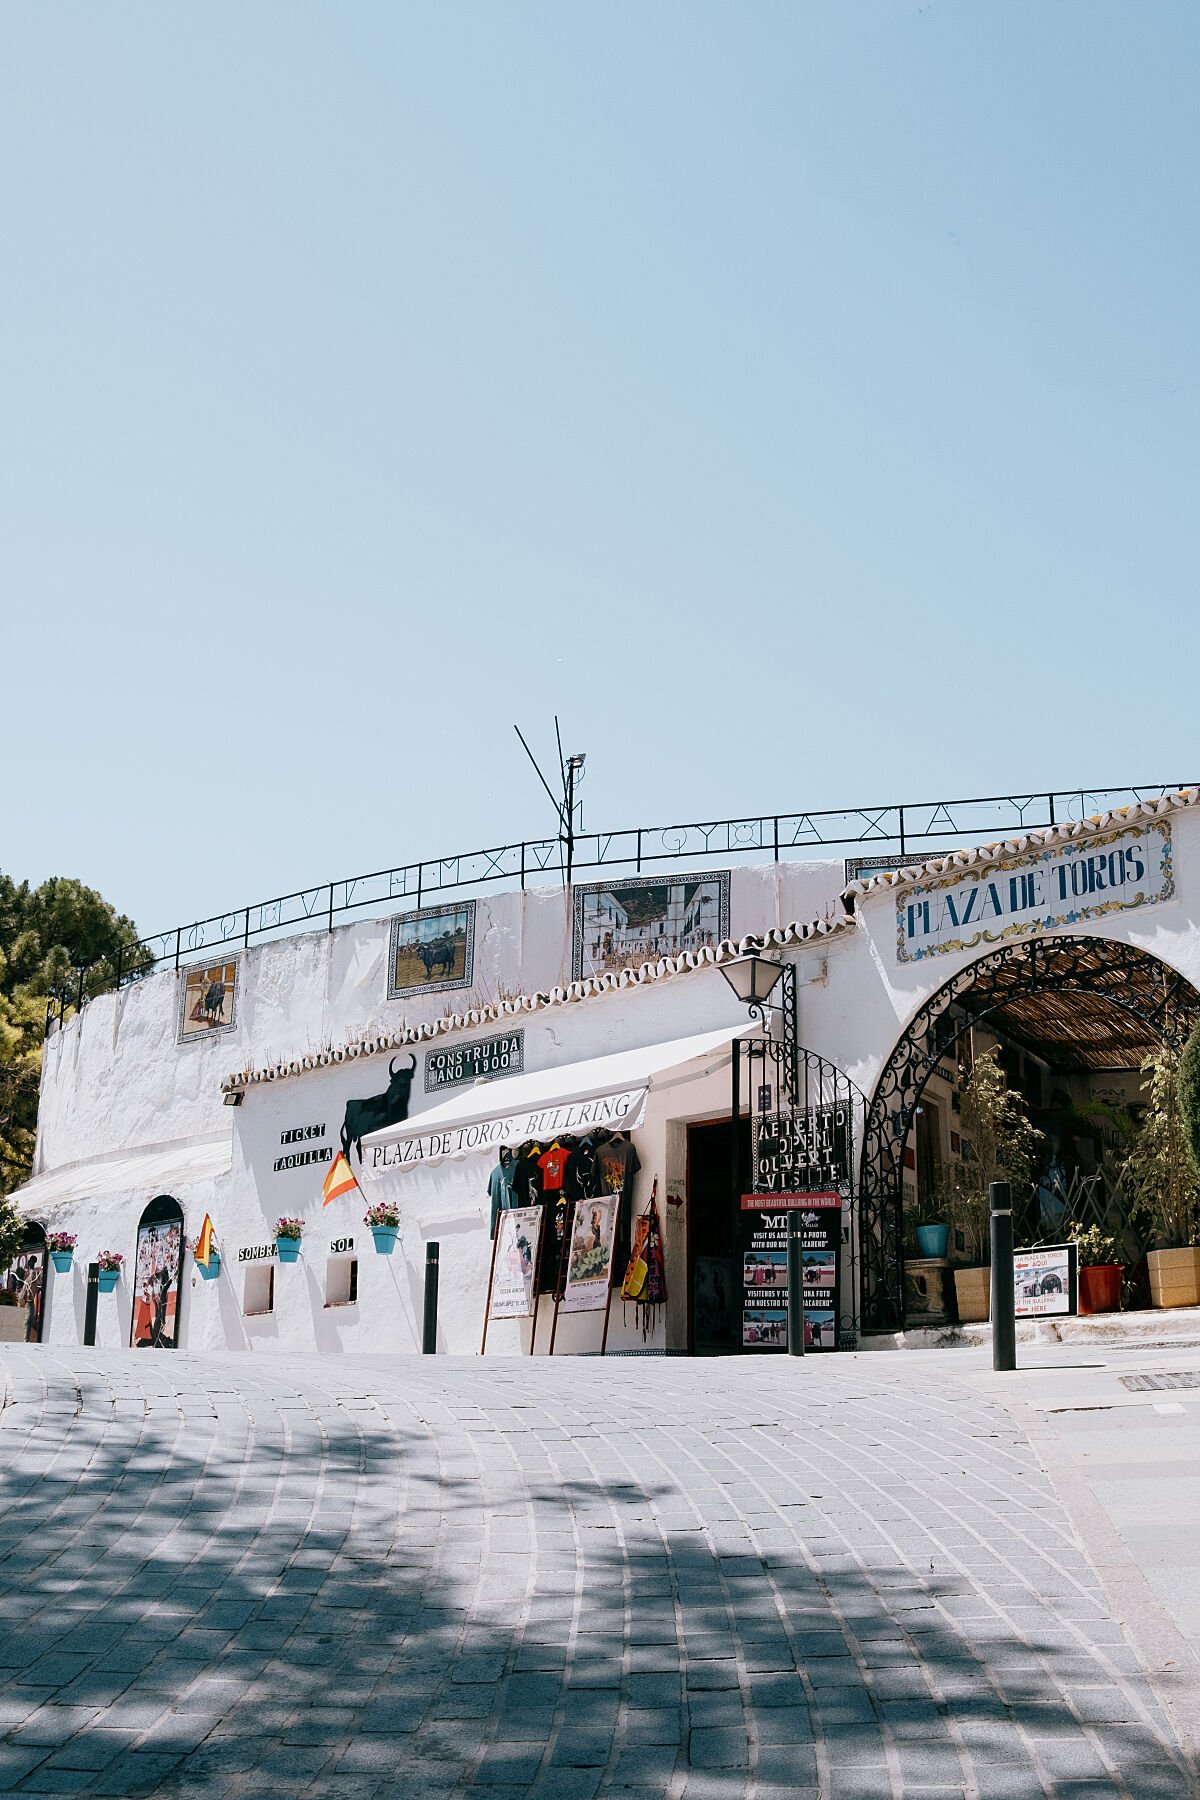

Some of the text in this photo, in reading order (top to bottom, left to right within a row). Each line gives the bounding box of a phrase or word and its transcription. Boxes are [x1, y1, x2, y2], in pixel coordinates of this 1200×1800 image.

[907, 845, 1145, 938] PLAZA DE TOROS
[429, 1038, 518, 1071] CONSTRUIDA
[474, 1053, 509, 1074] 1900
[281, 1124, 325, 1144] TICKET
[372, 1138, 424, 1167] PLAZA
[429, 1133, 452, 1157] DE
[457, 1120, 511, 1150] TOROS
[525, 1095, 631, 1135] BULLRING
[274, 1148, 332, 1171] TAQUILLA
[331, 1238, 353, 1253] SOL
